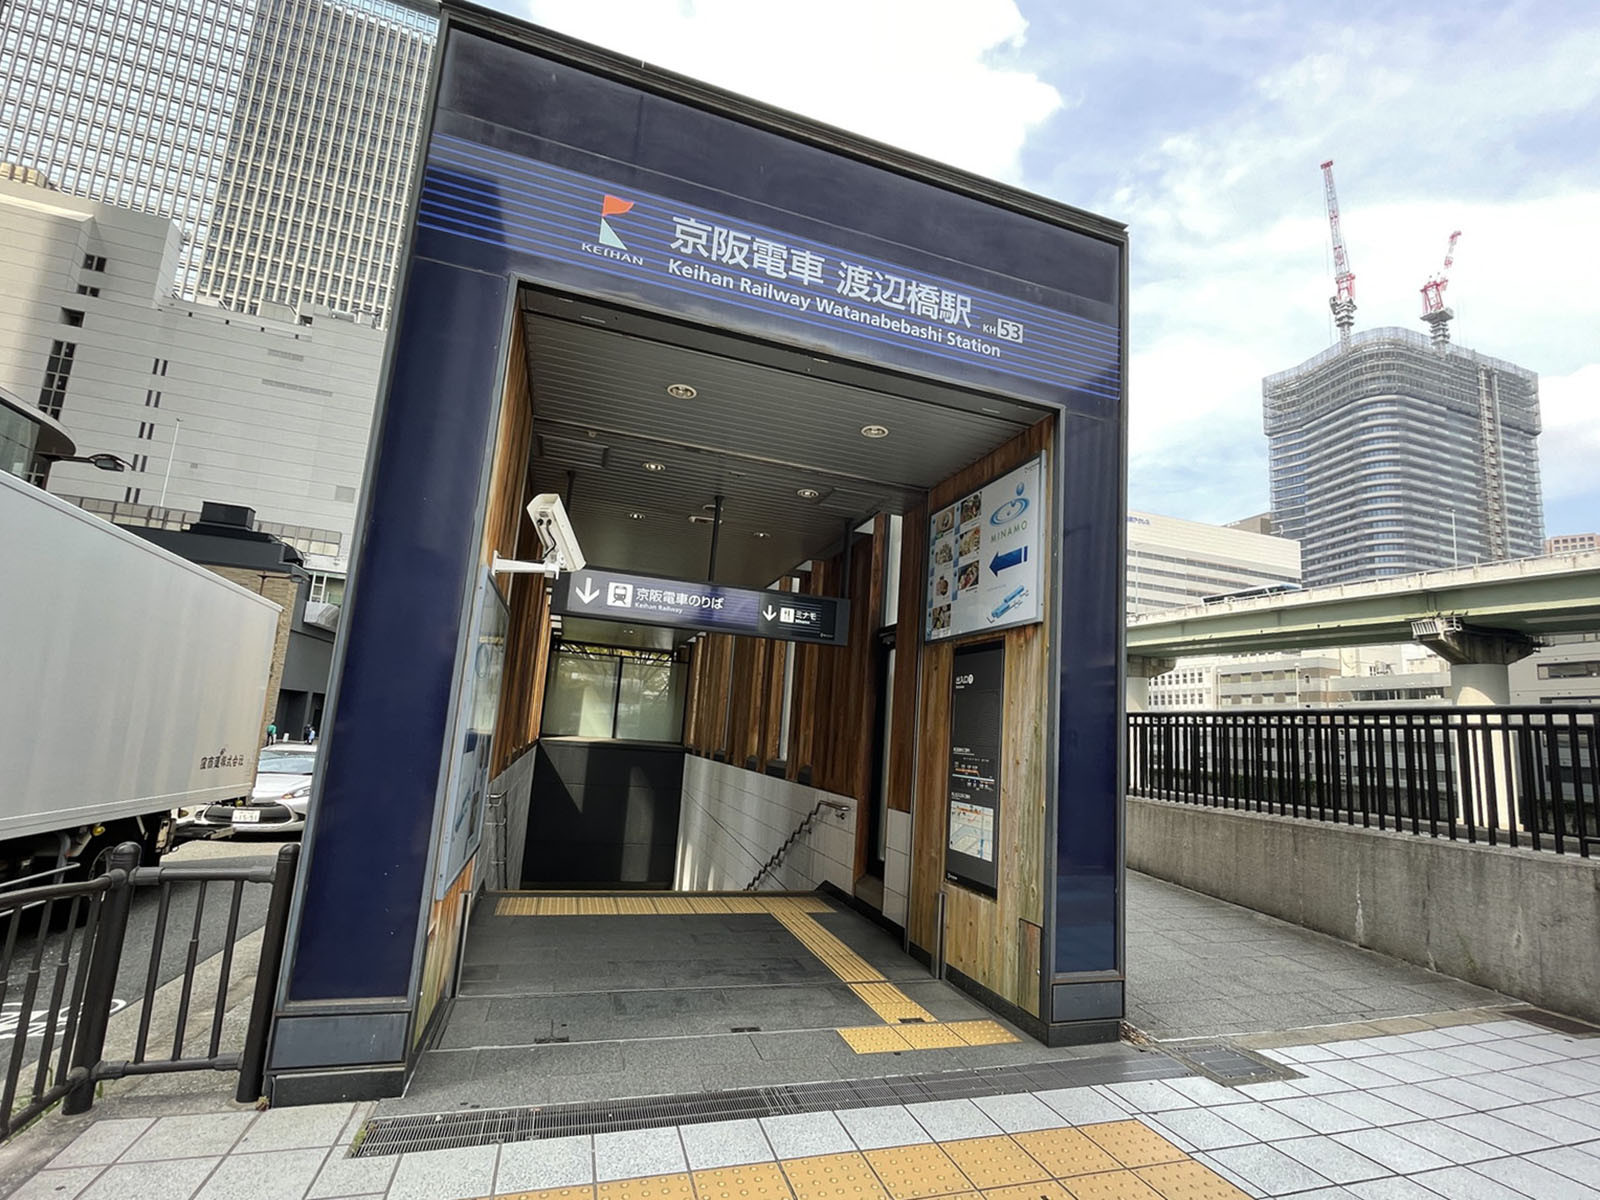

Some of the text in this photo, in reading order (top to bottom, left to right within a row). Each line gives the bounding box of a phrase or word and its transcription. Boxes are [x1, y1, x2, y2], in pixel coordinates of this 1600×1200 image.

[581, 242, 644, 266] KEIHAN
[670, 216, 971, 329] 京阪電車 渡辺橋駅
[668, 258, 1001, 358] Keihan Railway Watanabebashi Station
[982, 320, 1022, 342] KH 53
[990, 520, 1028, 542] MINAMO
[635, 602, 683, 615] Keihan Railway
[636, 588, 725, 609] 京阪電車のりば
[795, 610, 817, 621] ミナモ
